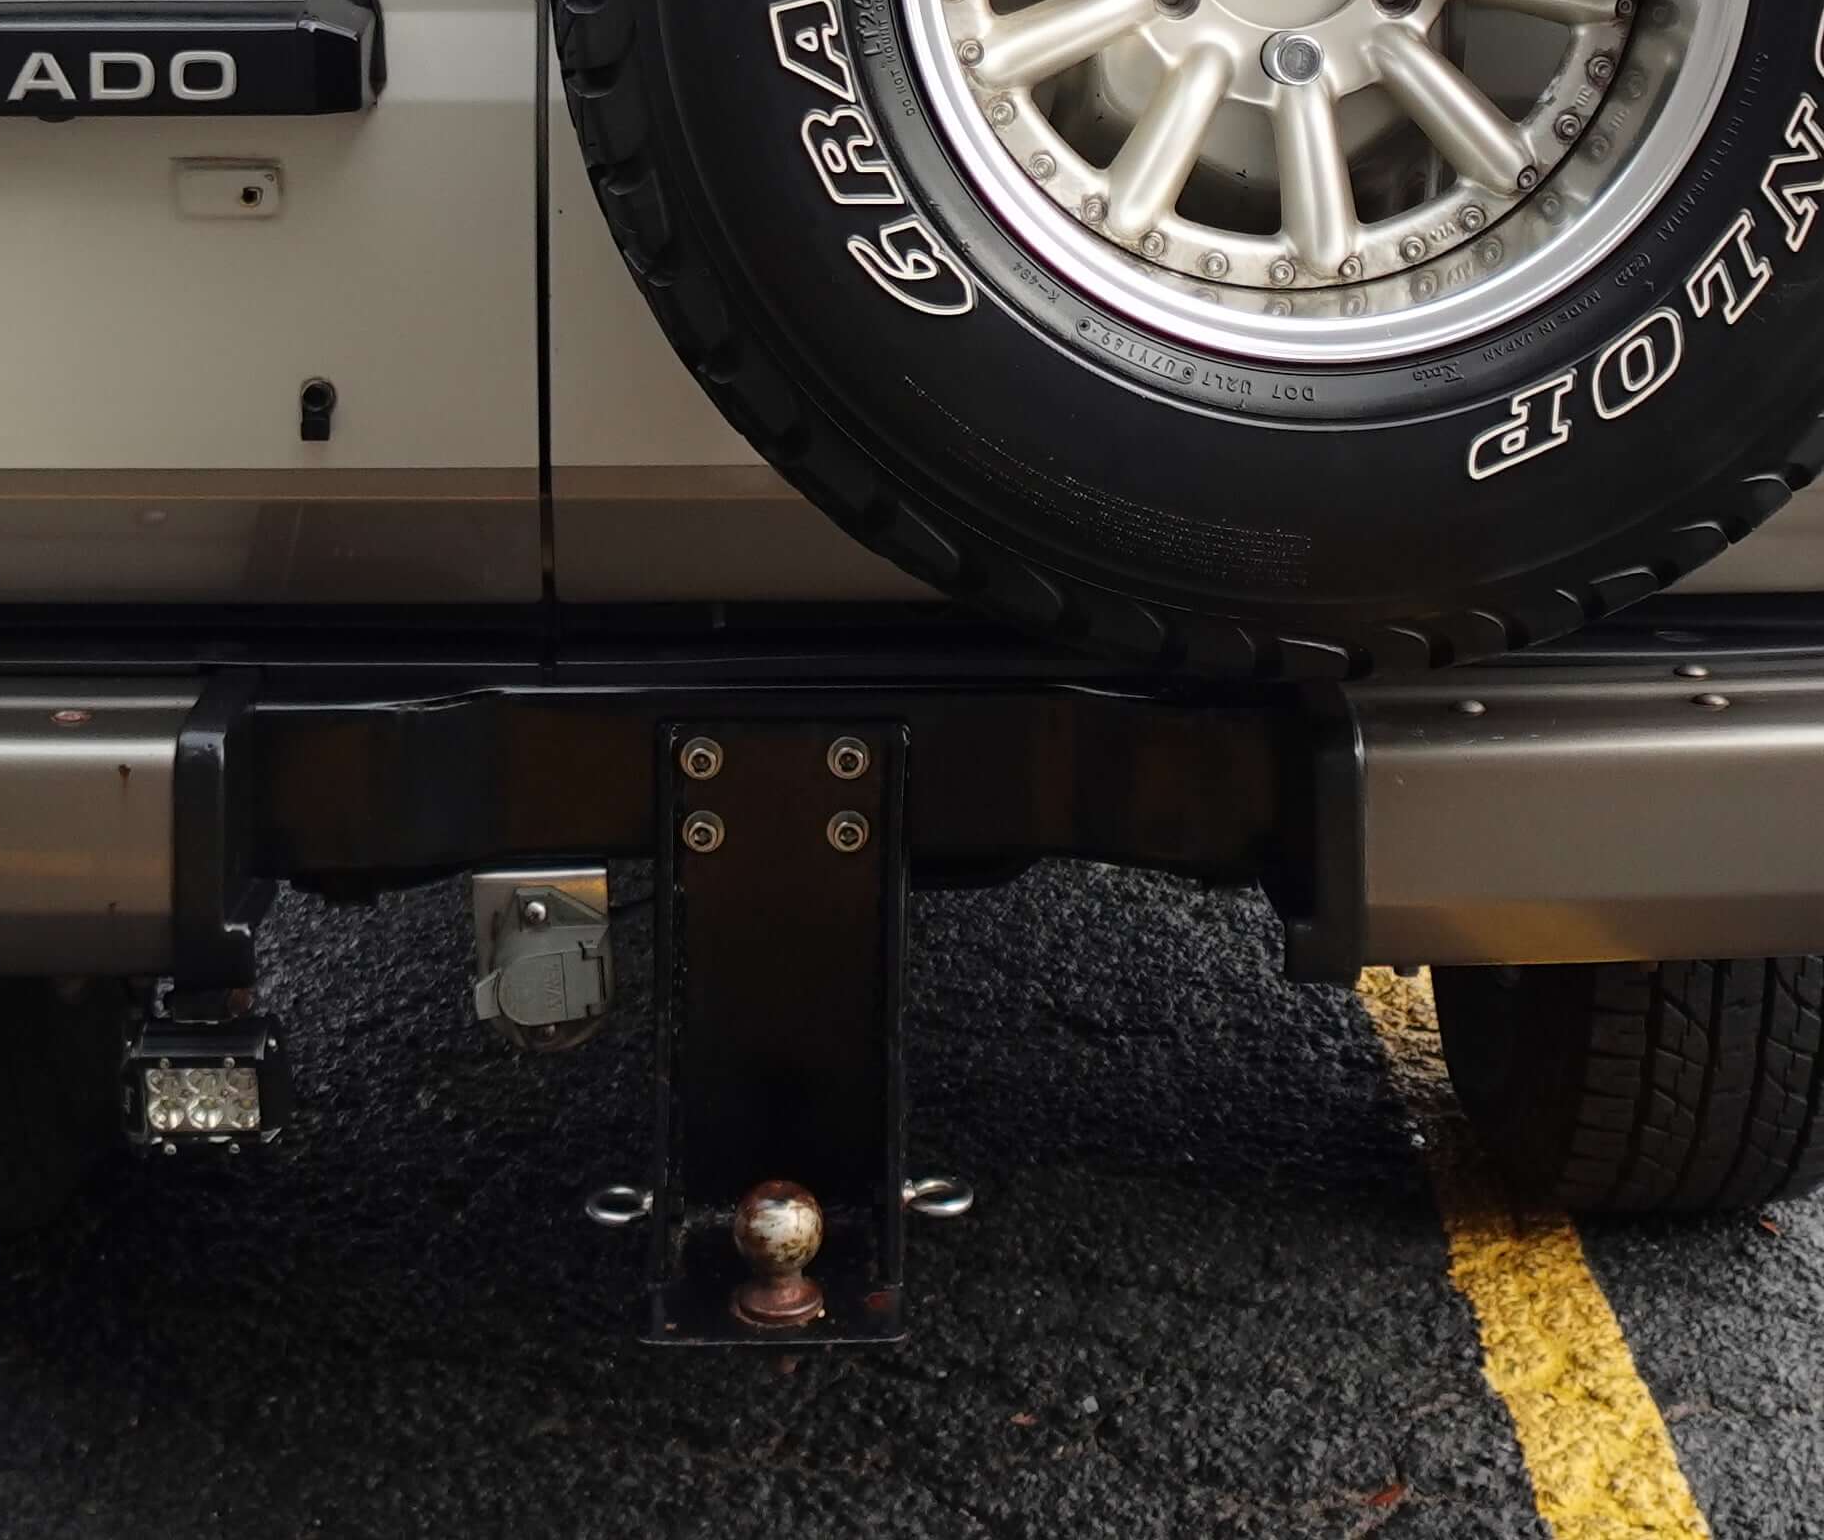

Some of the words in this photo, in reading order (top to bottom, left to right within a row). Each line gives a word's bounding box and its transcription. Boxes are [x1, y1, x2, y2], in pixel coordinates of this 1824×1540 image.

[1556, 288, 1603, 325] MADE
[1479, 329, 1536, 363] JAPAN
[1271, 383, 1315, 401] DOT
